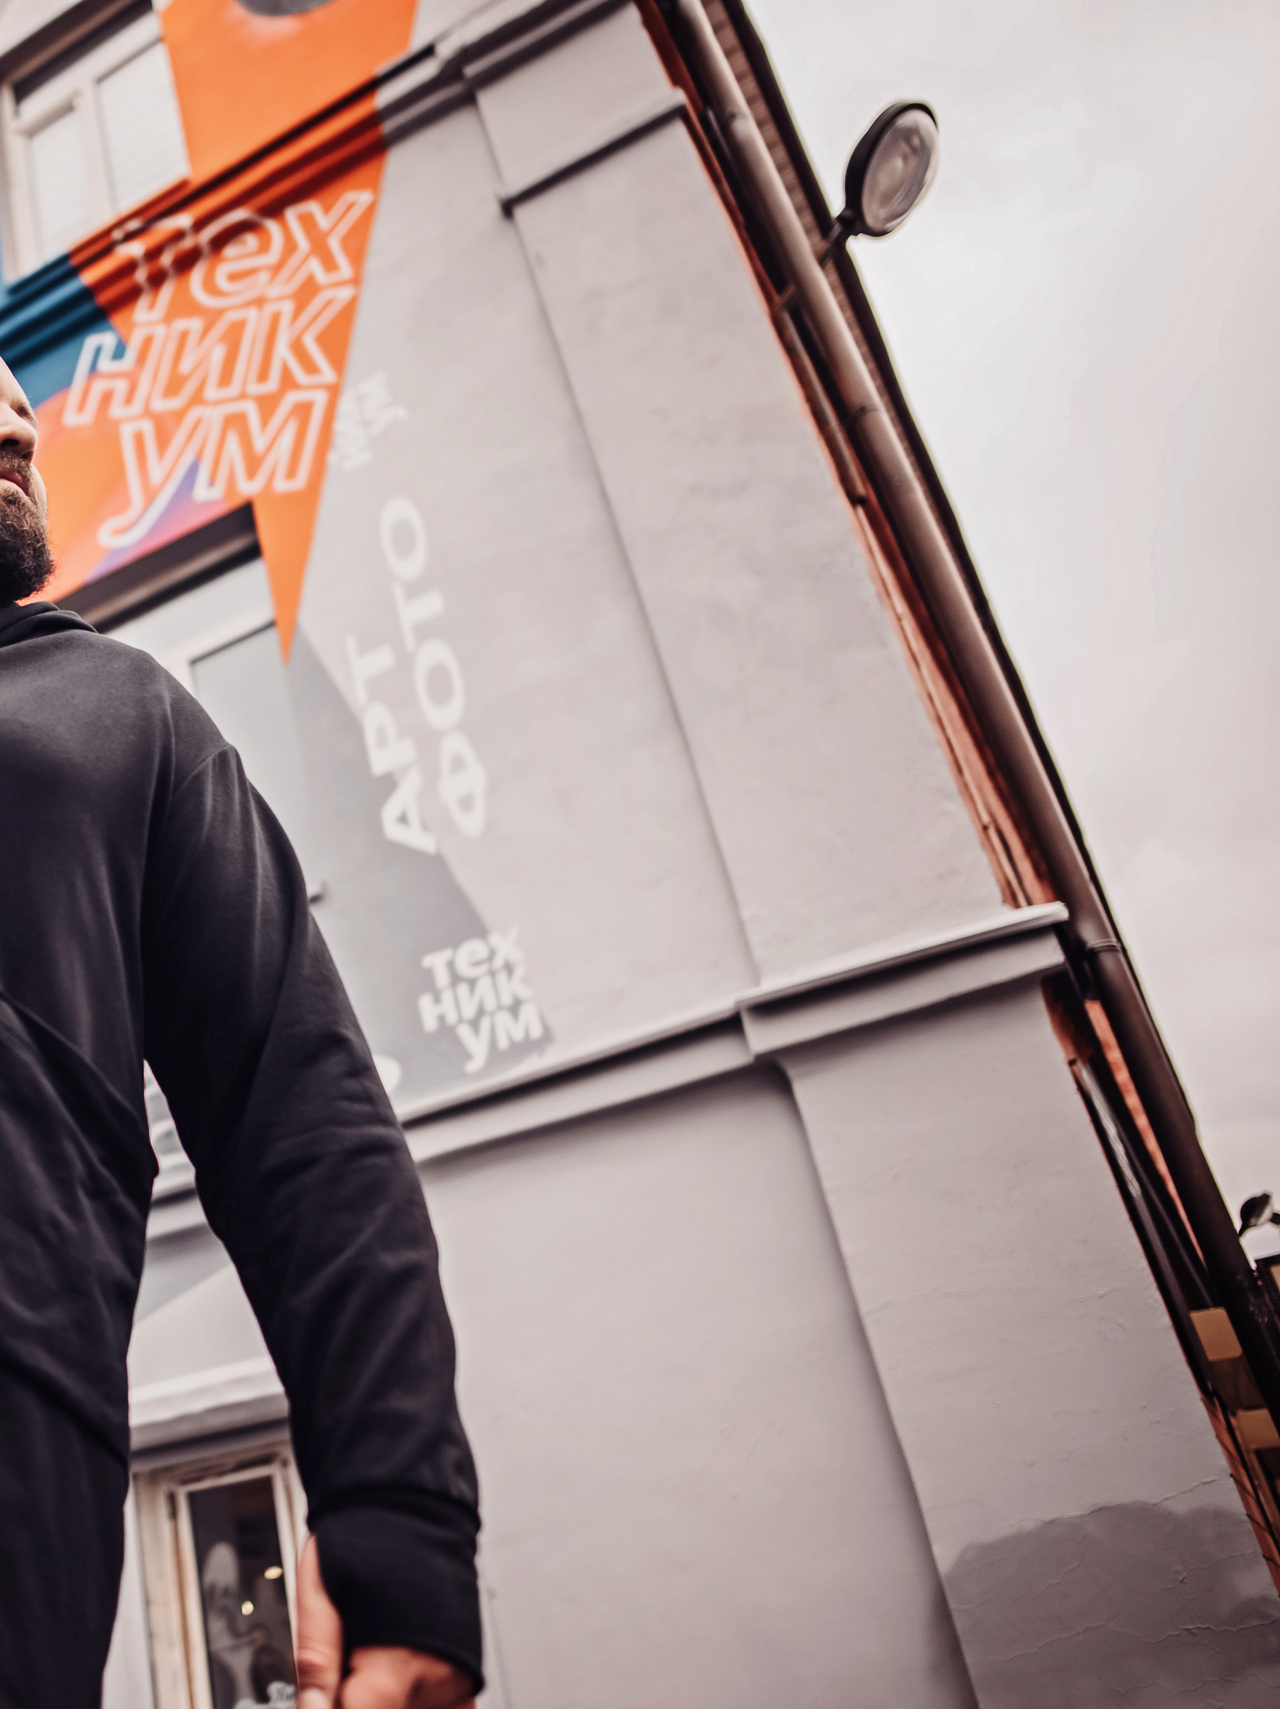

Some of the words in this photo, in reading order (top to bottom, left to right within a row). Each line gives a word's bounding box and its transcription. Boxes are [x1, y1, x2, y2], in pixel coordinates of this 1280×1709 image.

[112, 189, 374, 323] тех
[62, 284, 357, 427] ник
[96, 388, 328, 549] ум
[378, 494, 486, 839] ФОТО
[345, 633, 437, 856] АРТ
[417, 961, 533, 1034] ник
[420, 924, 523, 990] тех
[455, 1000, 543, 1074] ум
